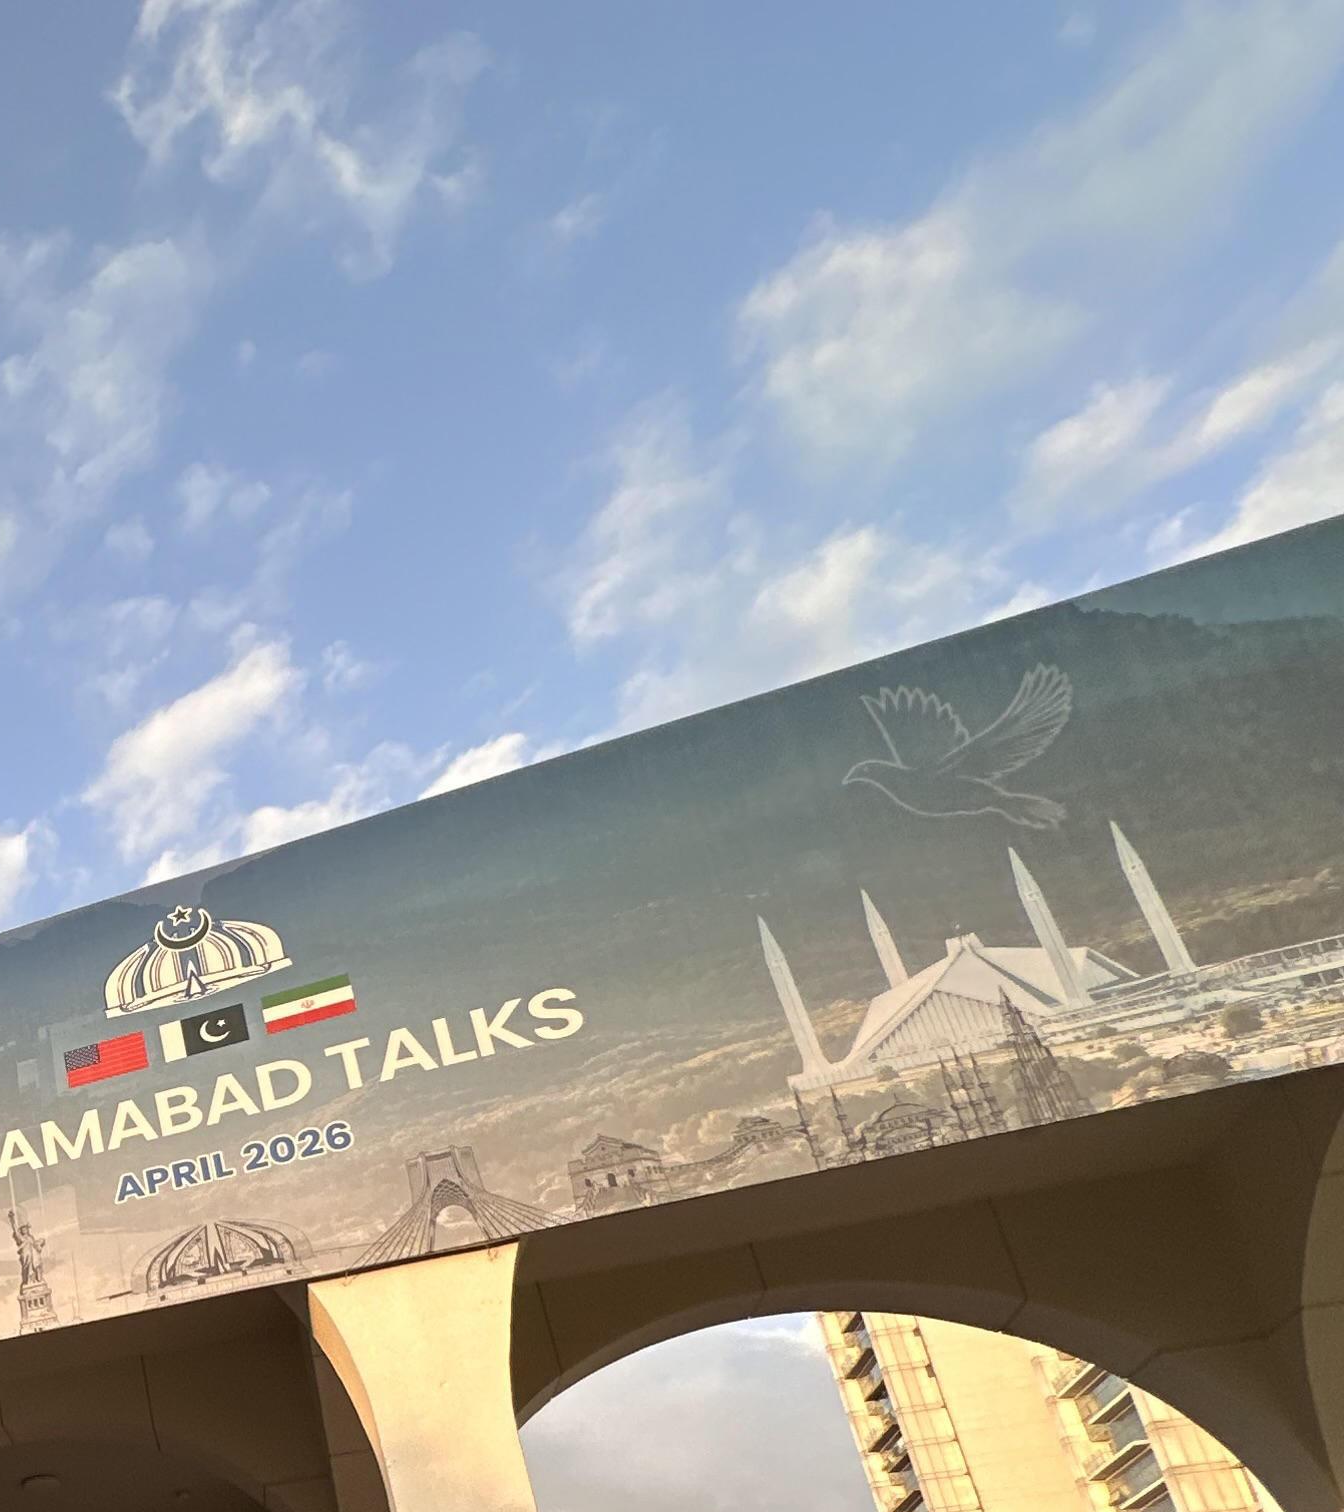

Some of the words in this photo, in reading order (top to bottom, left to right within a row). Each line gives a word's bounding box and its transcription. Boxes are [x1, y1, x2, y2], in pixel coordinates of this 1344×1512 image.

[323, 987, 586, 1091] TALKS
[114, 1148, 235, 1205] APRIL
[241, 1120, 355, 1174] 2026
